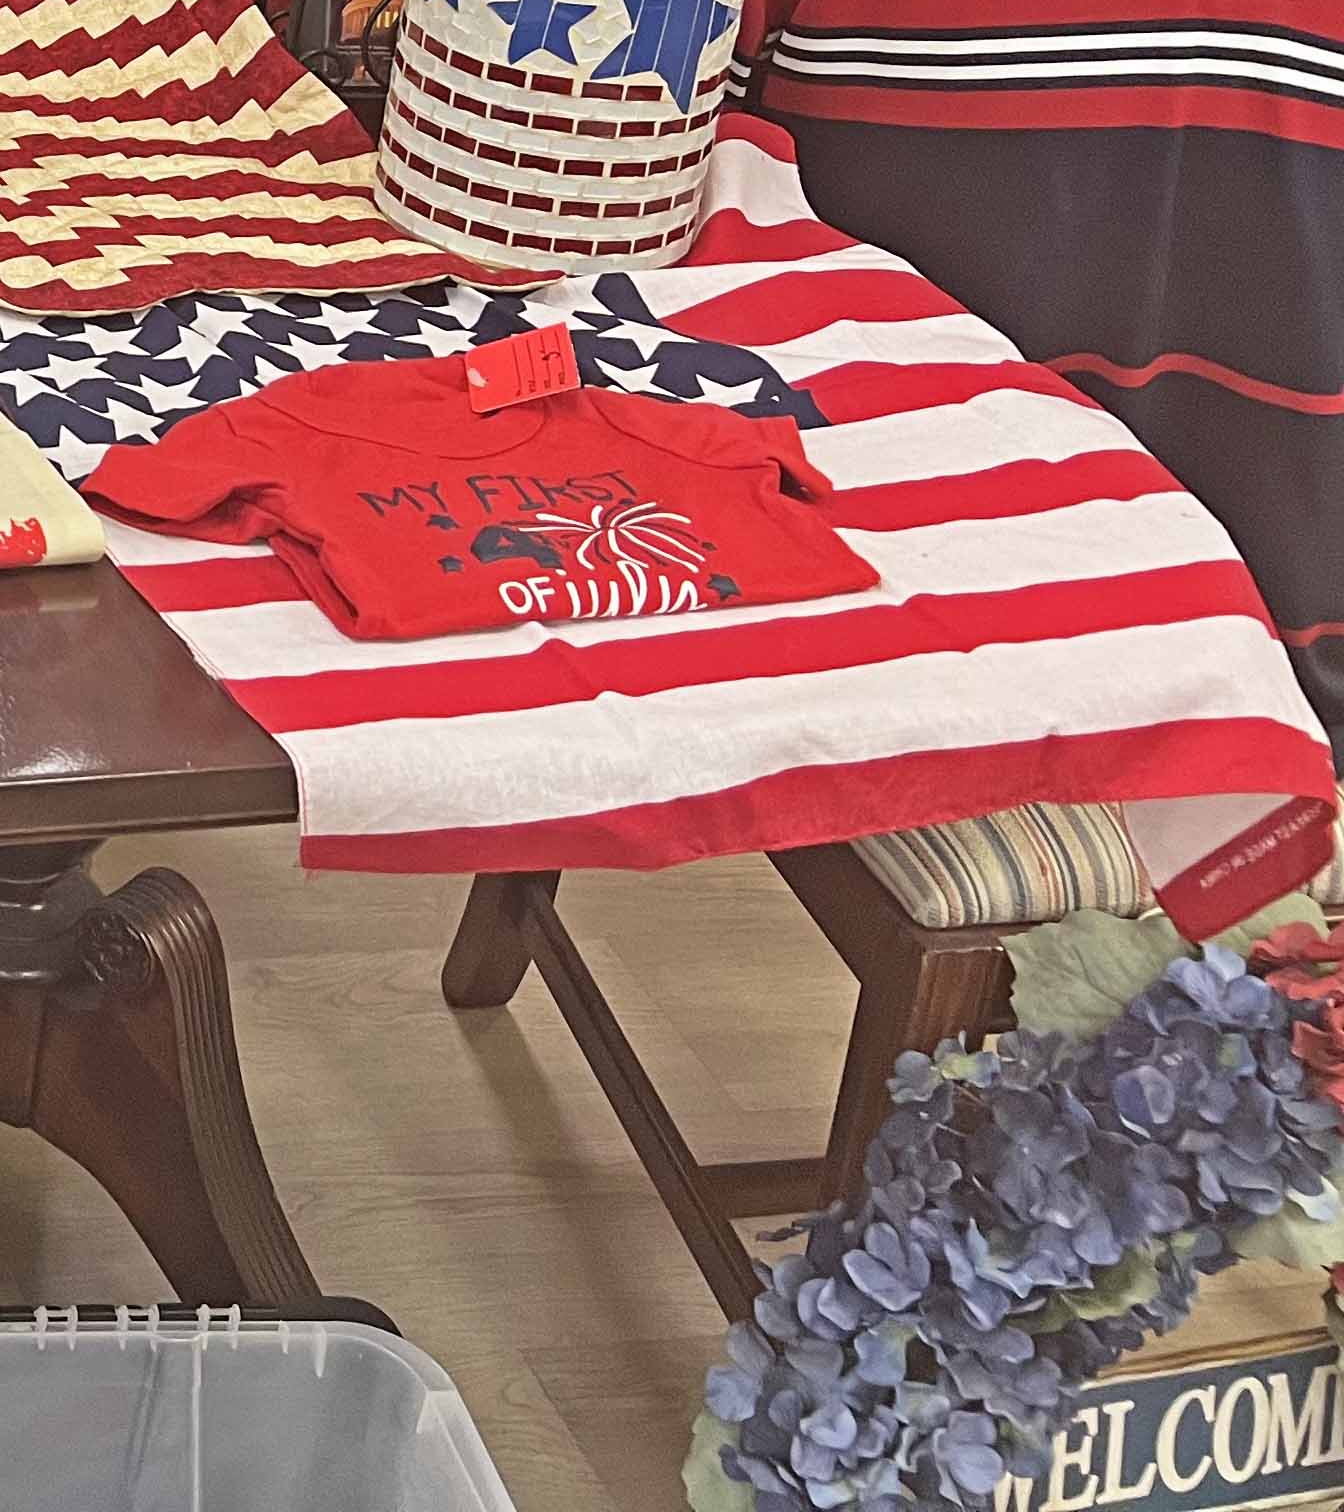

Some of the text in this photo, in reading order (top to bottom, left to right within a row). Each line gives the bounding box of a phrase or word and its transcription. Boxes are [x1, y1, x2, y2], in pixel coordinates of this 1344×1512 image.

[357, 470, 638, 517] MY FIRST
[498, 576, 556, 615] OF
[993, 1364, 1344, 1512] ELCOM
